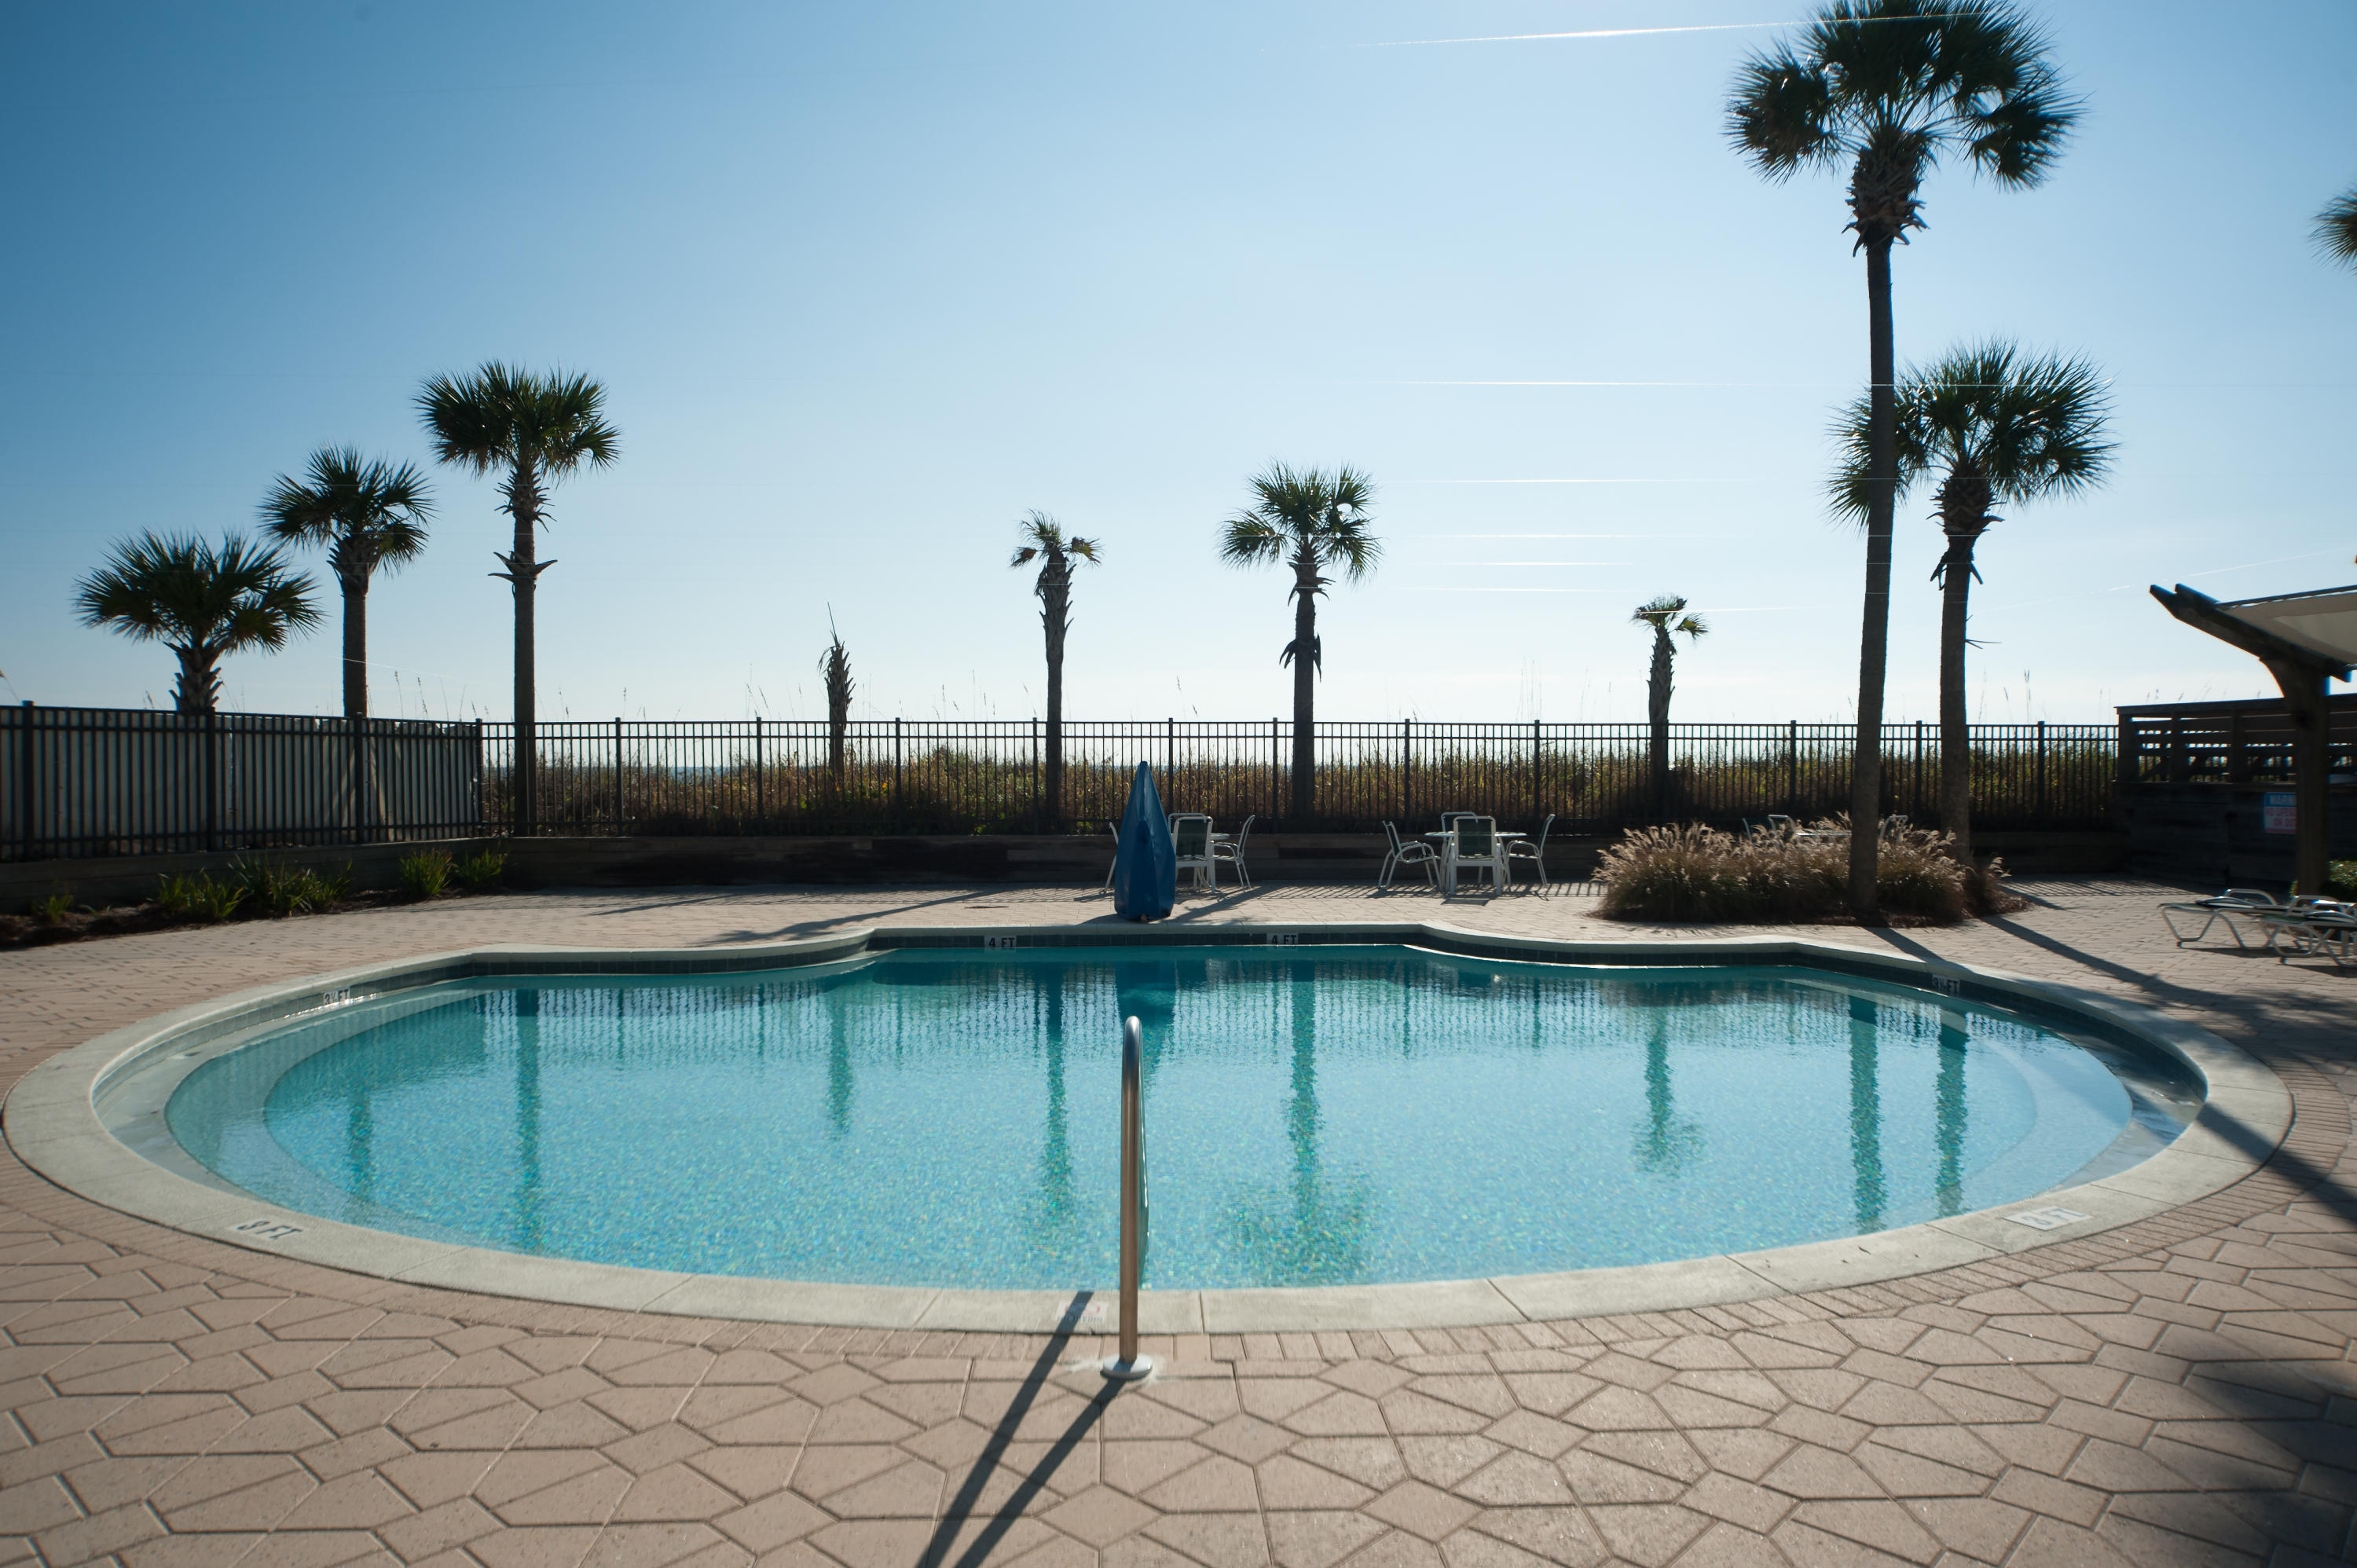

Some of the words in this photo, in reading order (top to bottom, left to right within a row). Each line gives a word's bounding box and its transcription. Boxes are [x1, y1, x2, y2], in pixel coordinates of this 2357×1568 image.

[988, 936, 996, 948] 4
[1001, 937, 1015, 948] FT
[1271, 934, 1278, 944] 4
[1283, 934, 1296, 944] FT
[2042, 1207, 2088, 1221] FT
[255, 1224, 303, 1240] FT
